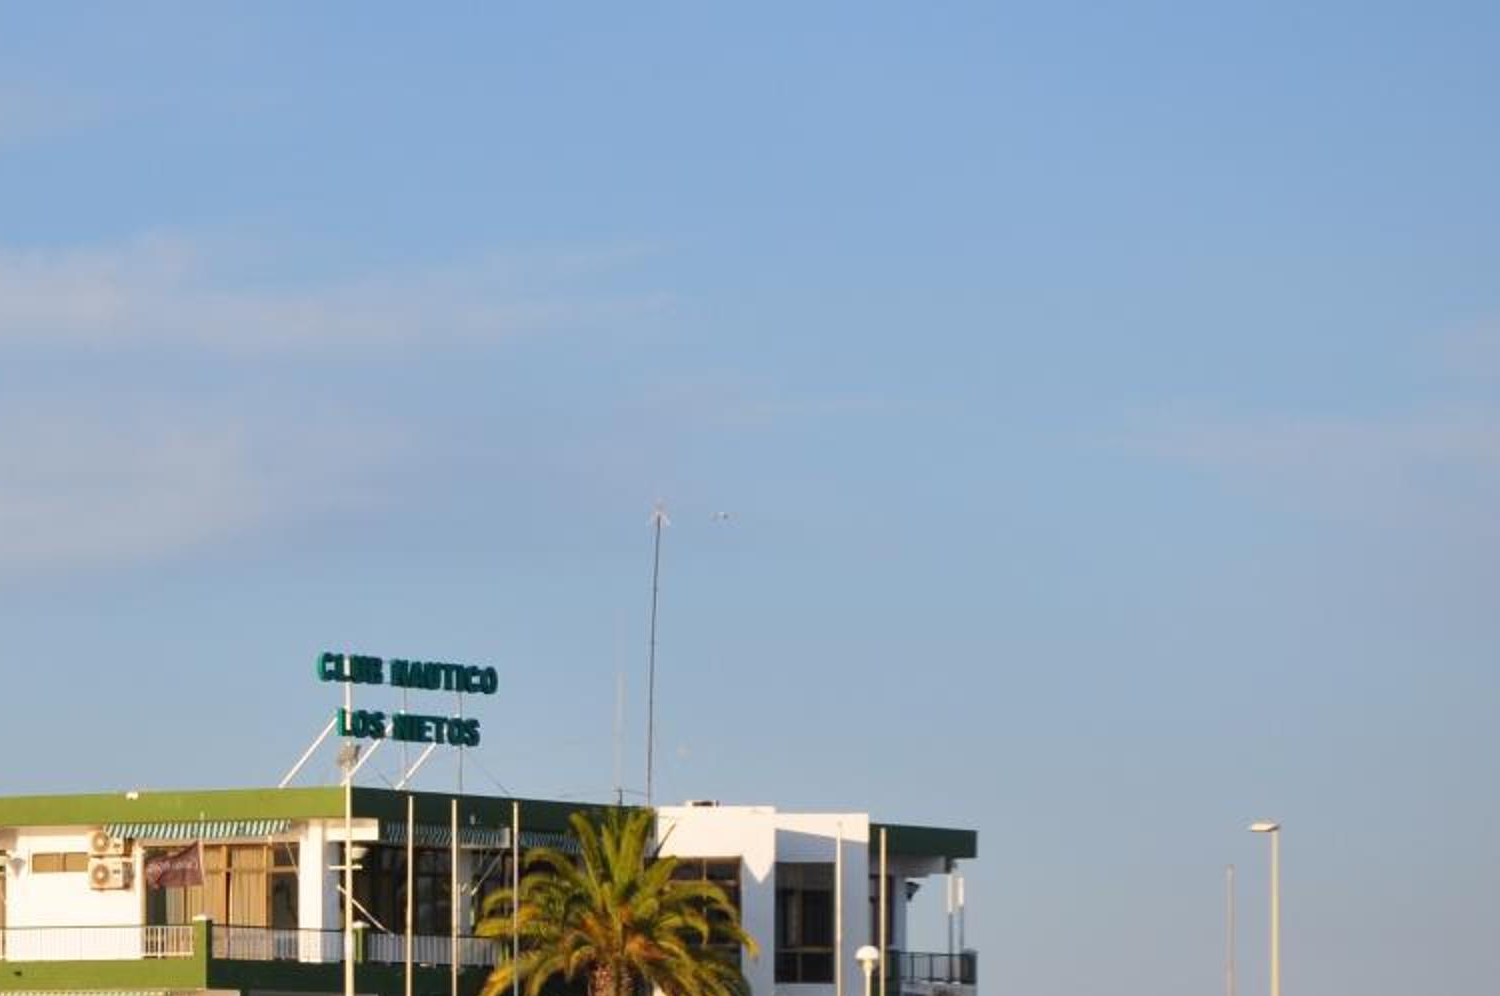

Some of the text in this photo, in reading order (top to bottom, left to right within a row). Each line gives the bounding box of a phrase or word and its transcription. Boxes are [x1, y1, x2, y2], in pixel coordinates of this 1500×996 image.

[317, 652, 497, 694] CLUB NAUTICO
[337, 707, 480, 747] LOS NIETOS
